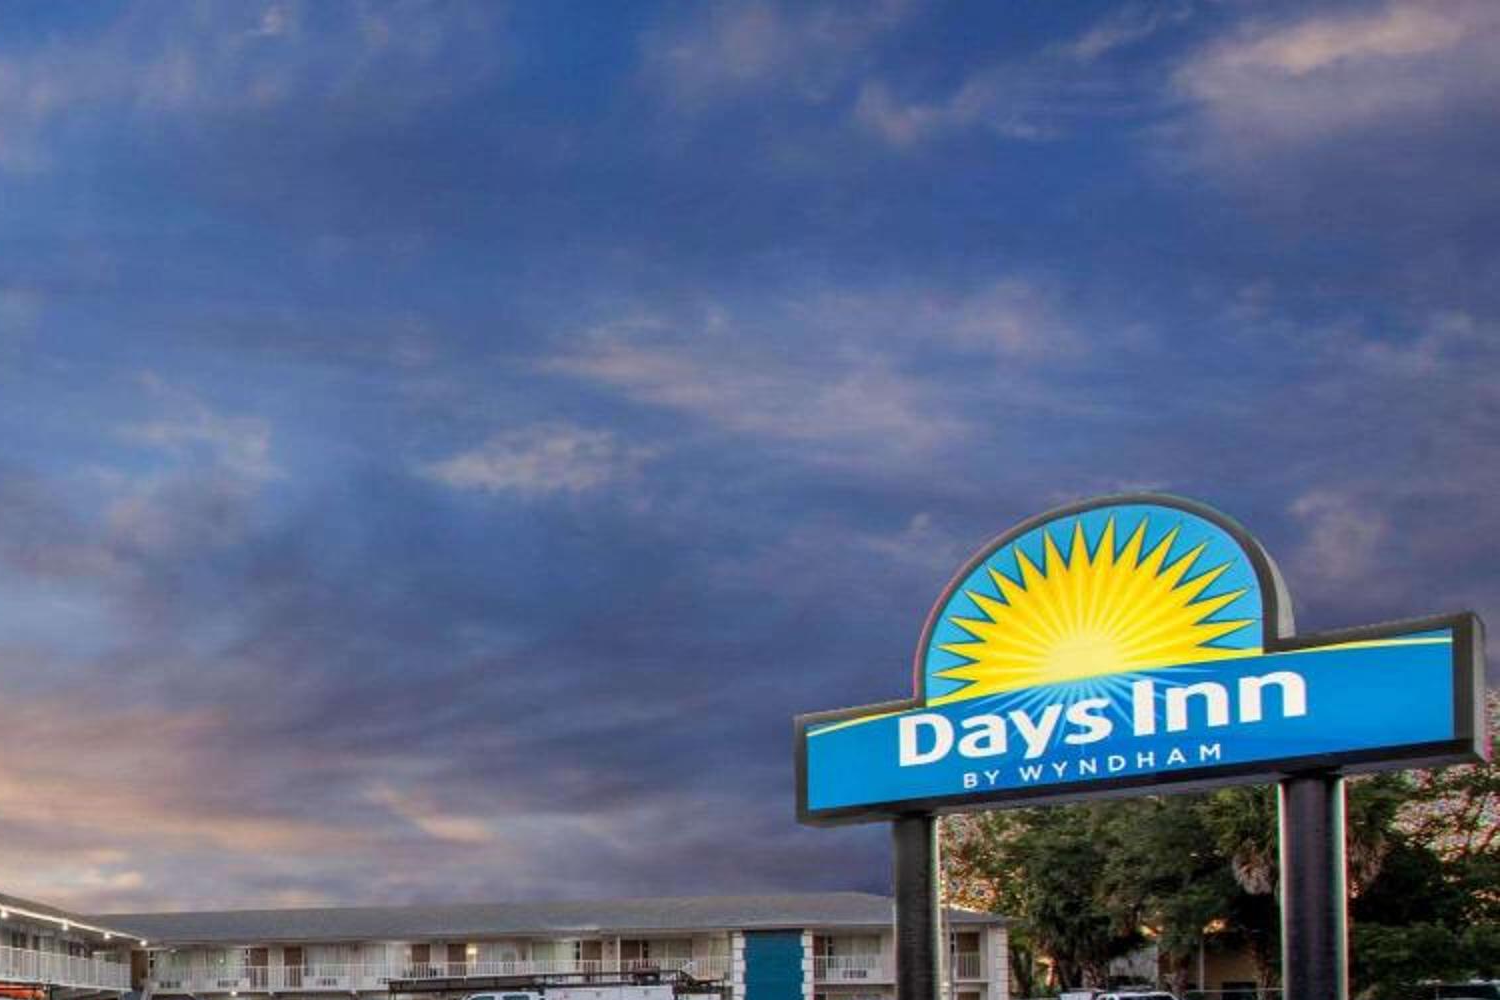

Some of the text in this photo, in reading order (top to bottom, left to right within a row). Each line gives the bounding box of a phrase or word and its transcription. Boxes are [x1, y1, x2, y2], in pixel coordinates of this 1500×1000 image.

[898, 671, 1308, 767] Days Inn
[963, 743, 1221, 789] BY WYNDHAM
